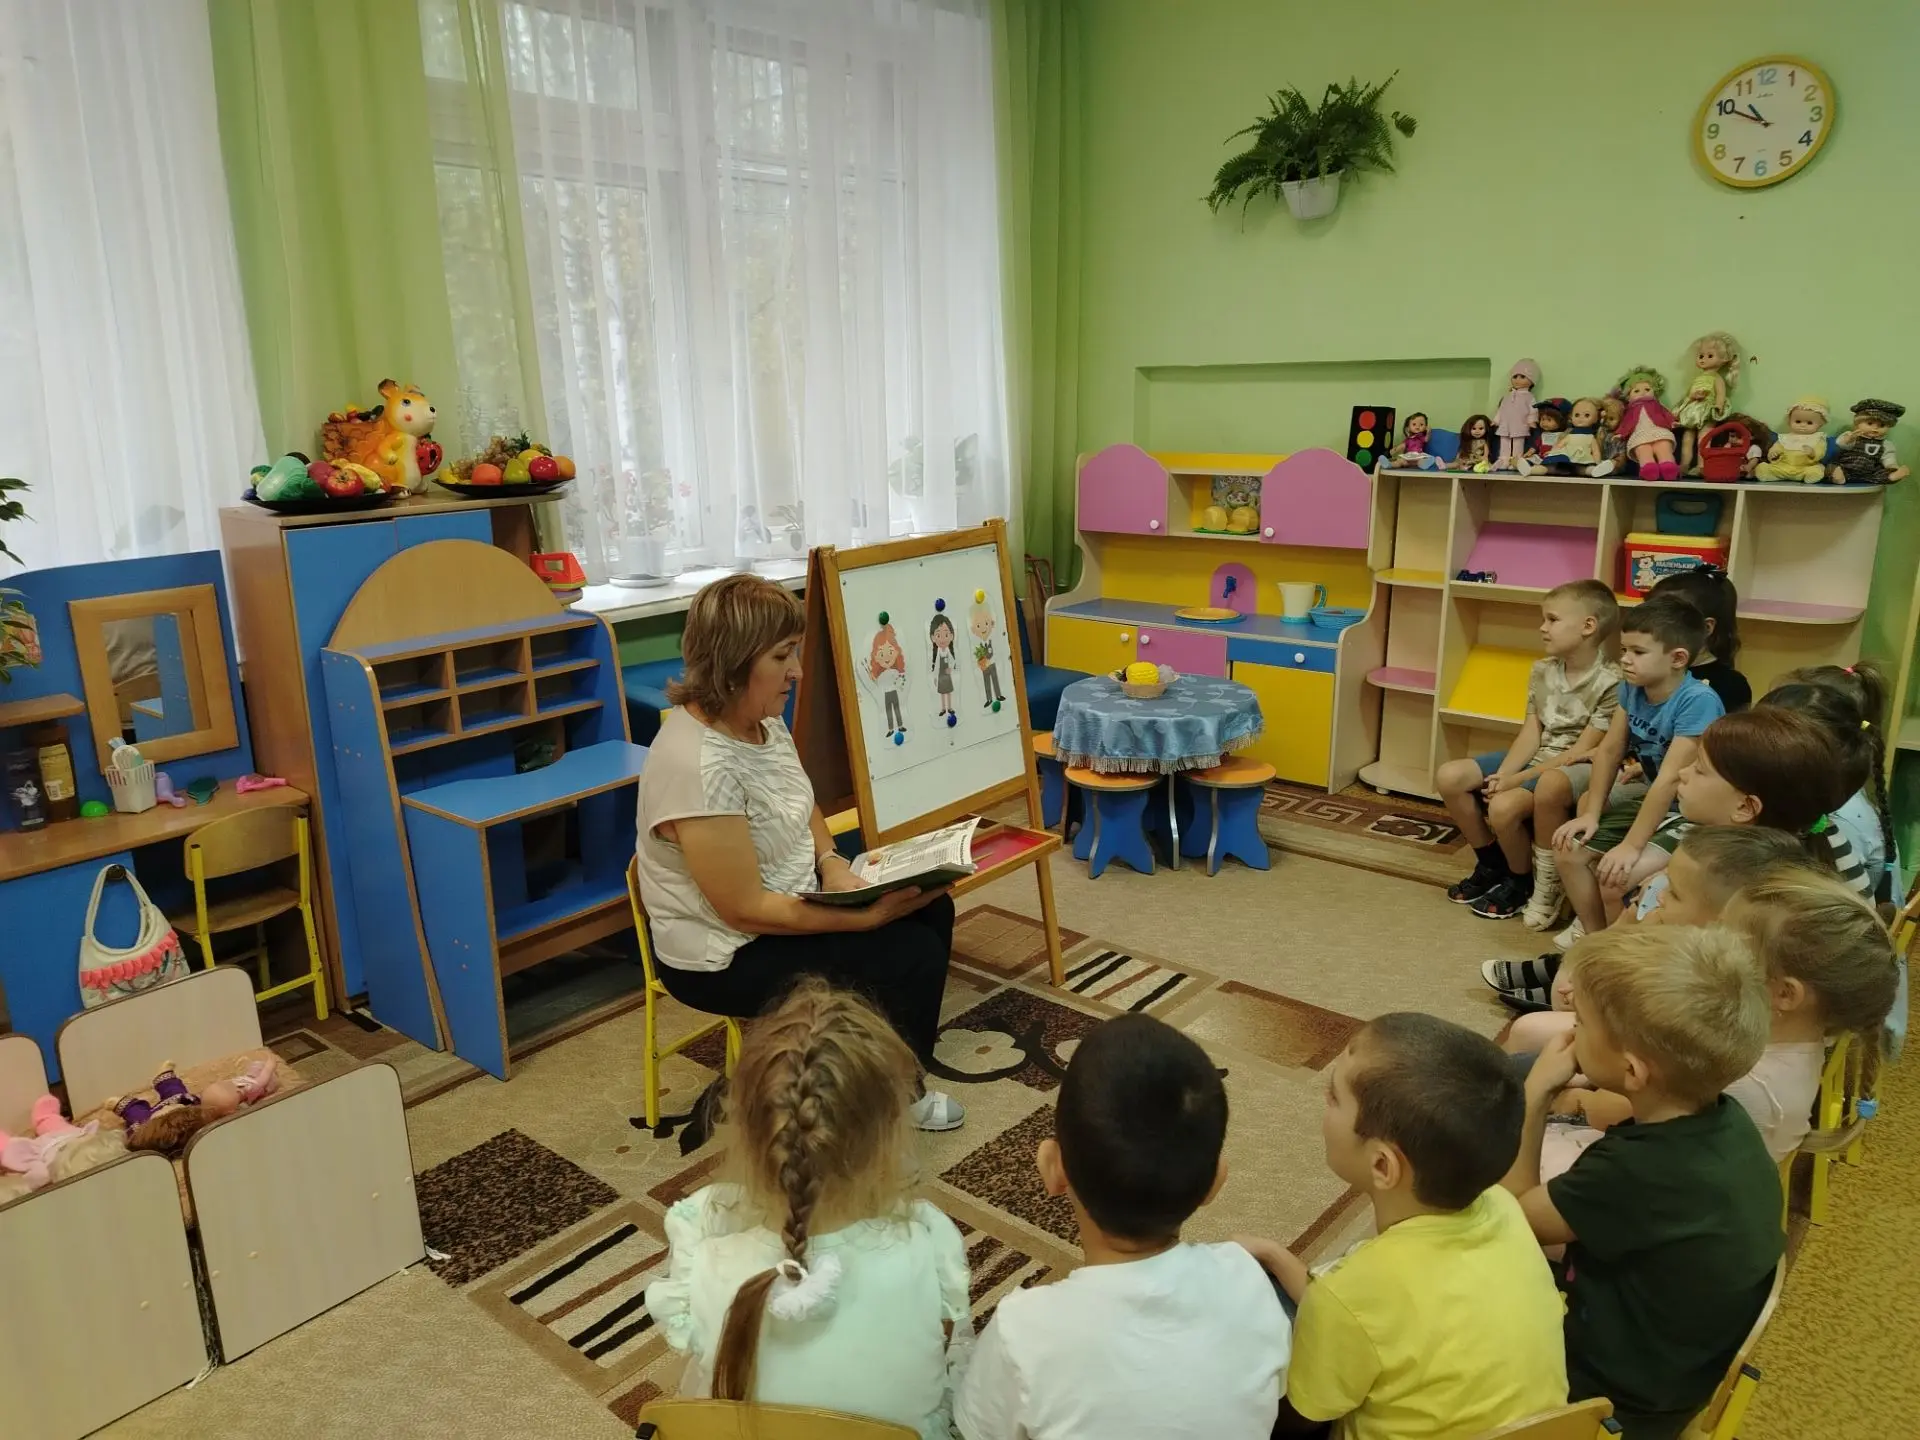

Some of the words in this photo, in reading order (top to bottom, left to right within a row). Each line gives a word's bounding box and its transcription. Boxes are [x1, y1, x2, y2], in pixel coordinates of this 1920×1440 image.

[1757, 68, 1778, 86] 12
[1788, 70, 1796, 87] 1
[1736, 78, 1753, 96] 11
[1803, 84, 1817, 102] 2
[1716, 98, 1736, 116] 10
[1810, 106, 1823, 122] 3
[1707, 123, 1720, 139] 9
[1798, 130, 1813, 147] 4
[1714, 144, 1726, 160] 8
[1779, 149, 1793, 167] 5
[1733, 156, 1746, 174] 7
[1754, 160, 1767, 177] 6
